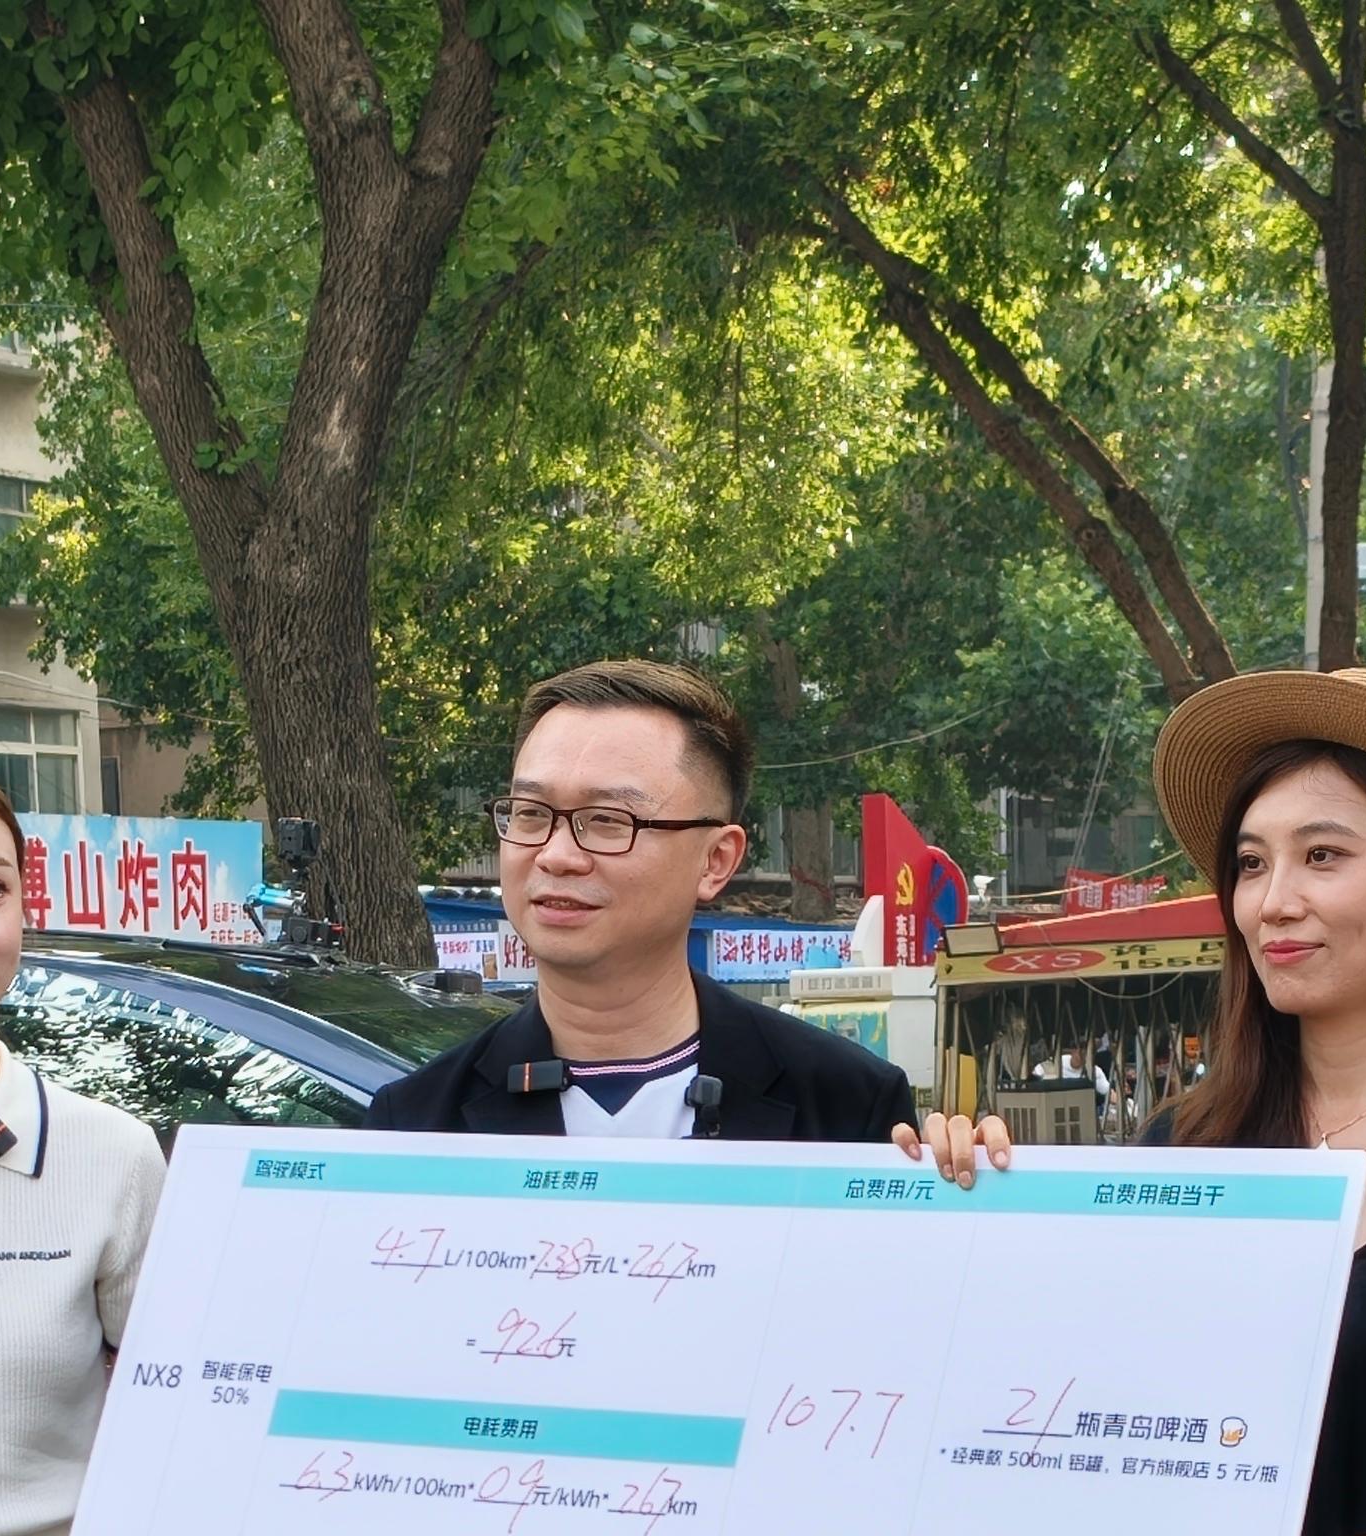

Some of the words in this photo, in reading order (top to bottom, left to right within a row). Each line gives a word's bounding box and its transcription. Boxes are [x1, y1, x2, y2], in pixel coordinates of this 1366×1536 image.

[255, 1160, 326, 1181] 驾驶模式
[523, 1170, 598, 1191] 油耗费用
[845, 1179, 935, 1201] 总费用/元
[132, 1364, 183, 1389] NX8
[201, 1361, 272, 1383] 智能保电
[211, 1386, 250, 1405] 50%
[463, 1418, 538, 1440] 电耗费用
[1075, 1410, 1208, 1444] 瓶青岛啤酒
